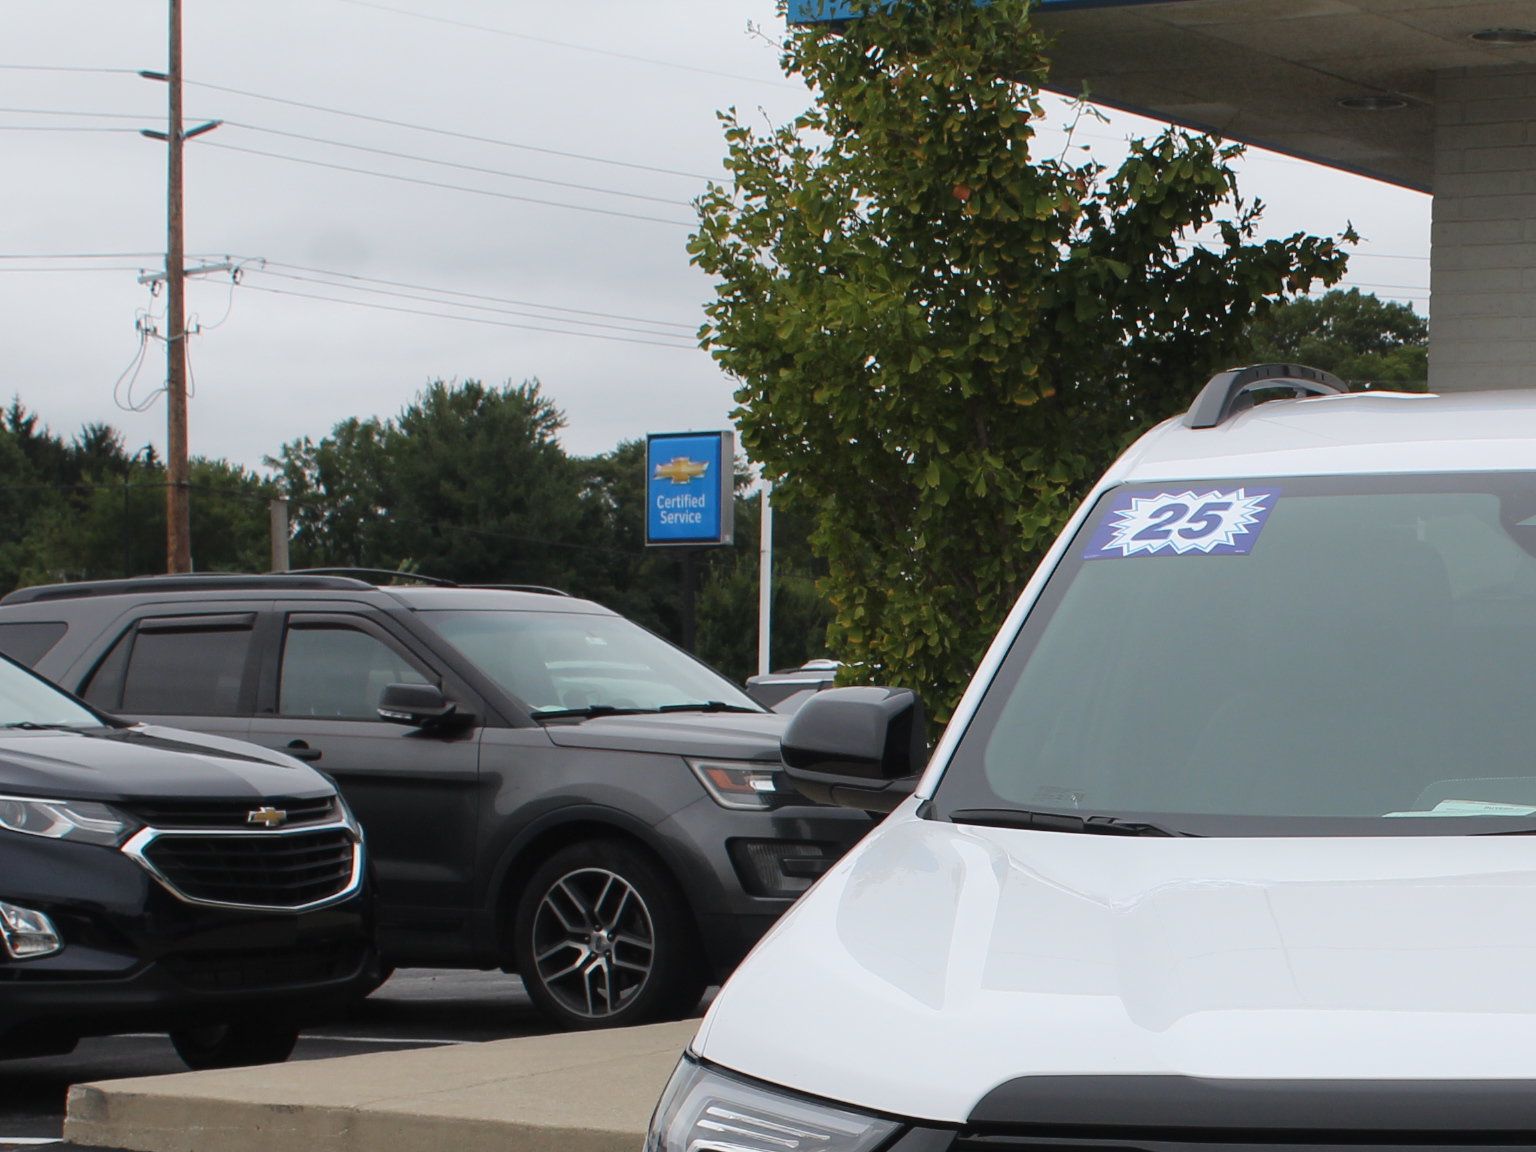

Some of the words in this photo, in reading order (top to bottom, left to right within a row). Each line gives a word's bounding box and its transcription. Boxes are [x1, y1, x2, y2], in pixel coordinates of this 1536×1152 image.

[656, 494, 706, 509] Certified
[660, 510, 702, 524] Service
[1130, 501, 1233, 541] 25
